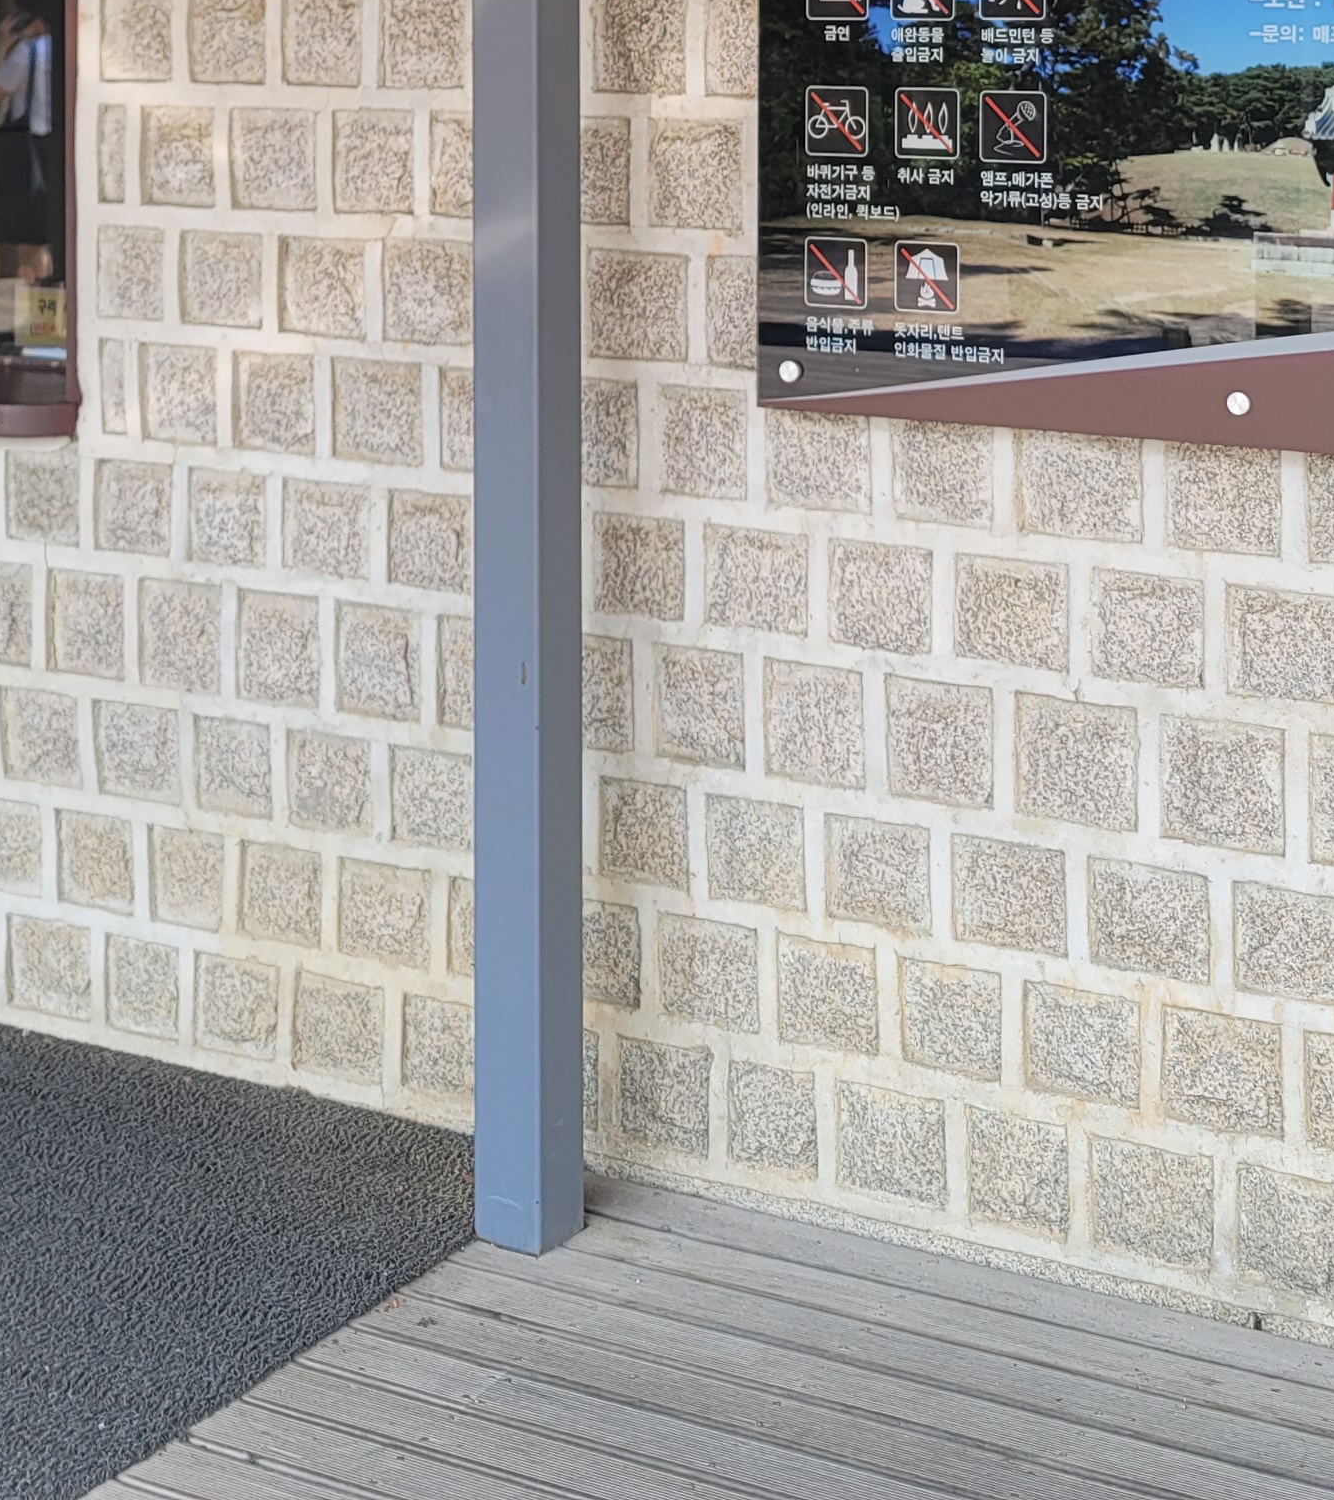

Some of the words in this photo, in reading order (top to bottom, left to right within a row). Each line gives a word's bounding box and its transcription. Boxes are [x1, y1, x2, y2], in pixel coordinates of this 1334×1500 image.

[824, 25, 850, 41] 금연
[891, 27, 944, 43] 애완동물
[981, 28, 1036, 44] 배드민턴
[1040, 28, 1054, 44] 등
[1012, 47, 1040, 63] 금지
[806, 164, 858, 181] 바퀴기구
[861, 165, 875, 181] 등
[897, 168, 924, 184] 취사
[927, 169, 955, 186] 금지
[980, 170, 1054, 189] 앰프,메가폰
[806, 184, 871, 201] 자전거금지
[1075, 194, 1104, 211] 금지
[805, 203, 853, 221] (인라인,
[805, 335, 857, 355] 반입금지
[893, 341, 946, 360] 인화물질
[950, 344, 1005, 365] 반입금지
